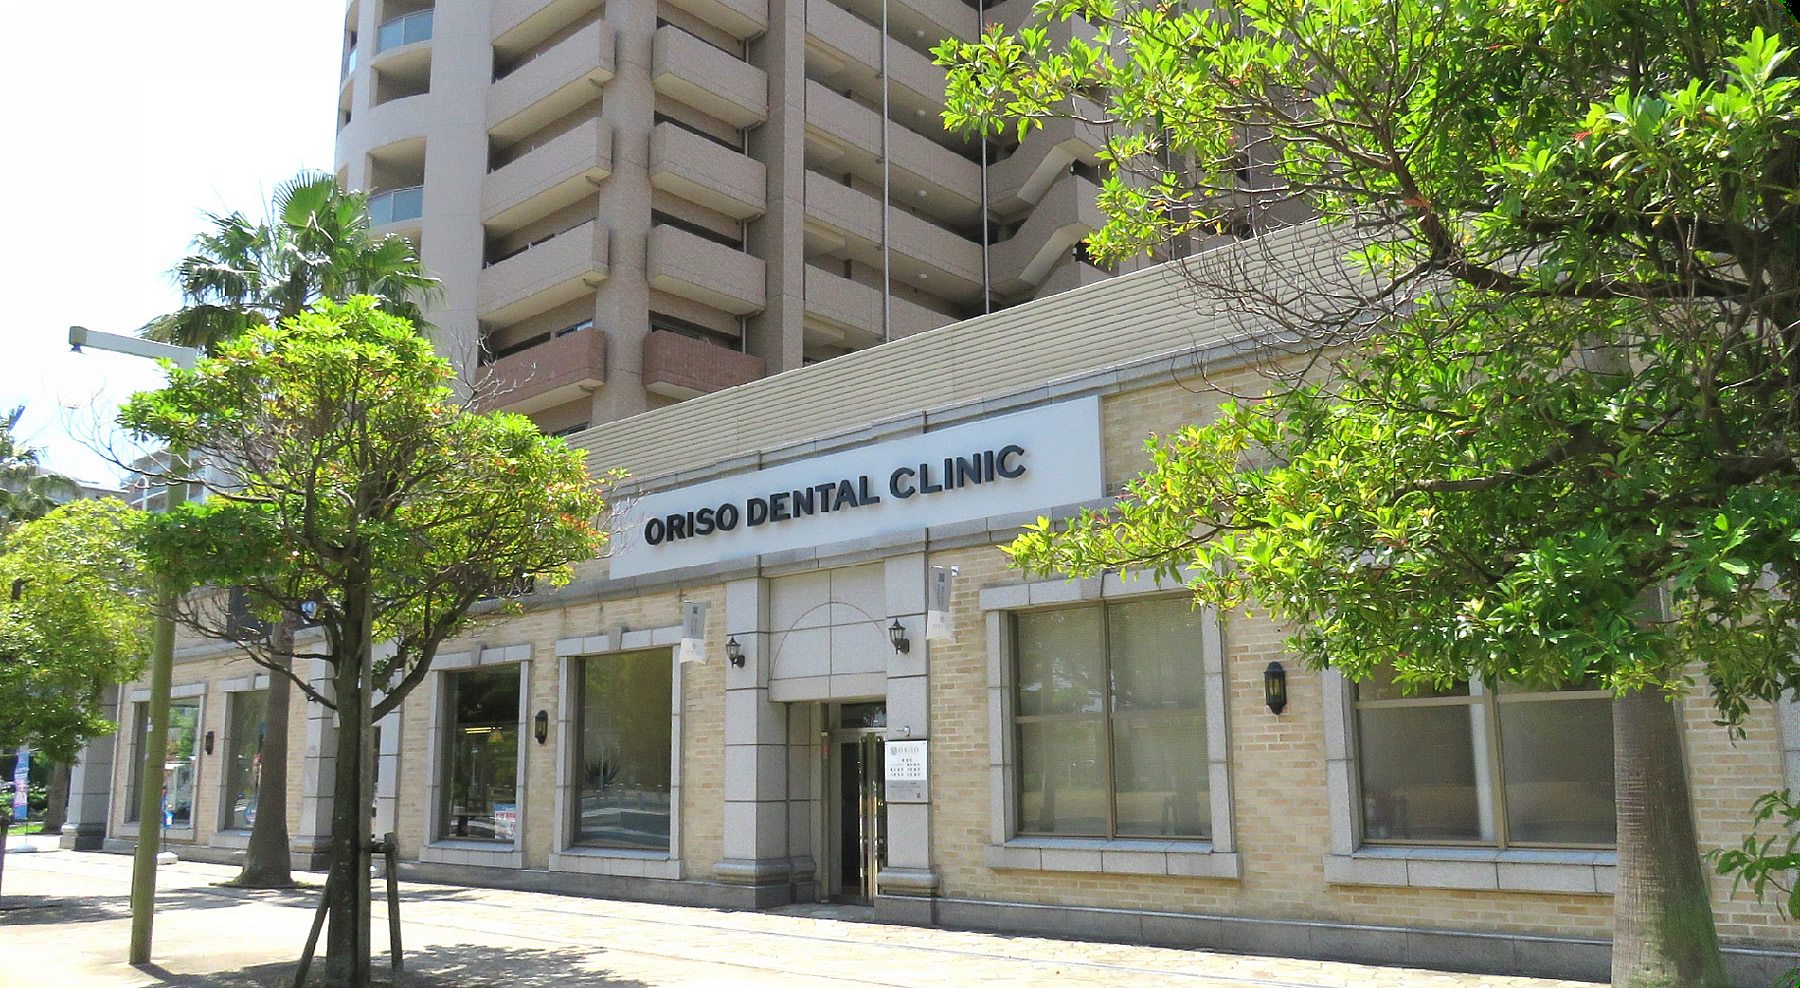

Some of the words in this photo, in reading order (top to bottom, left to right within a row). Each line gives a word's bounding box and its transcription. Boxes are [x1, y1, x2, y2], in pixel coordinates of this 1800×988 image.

[644, 503, 739, 546] ORISO
[747, 475, 880, 527] DENTAL
[889, 444, 1026, 499] CLINIC
